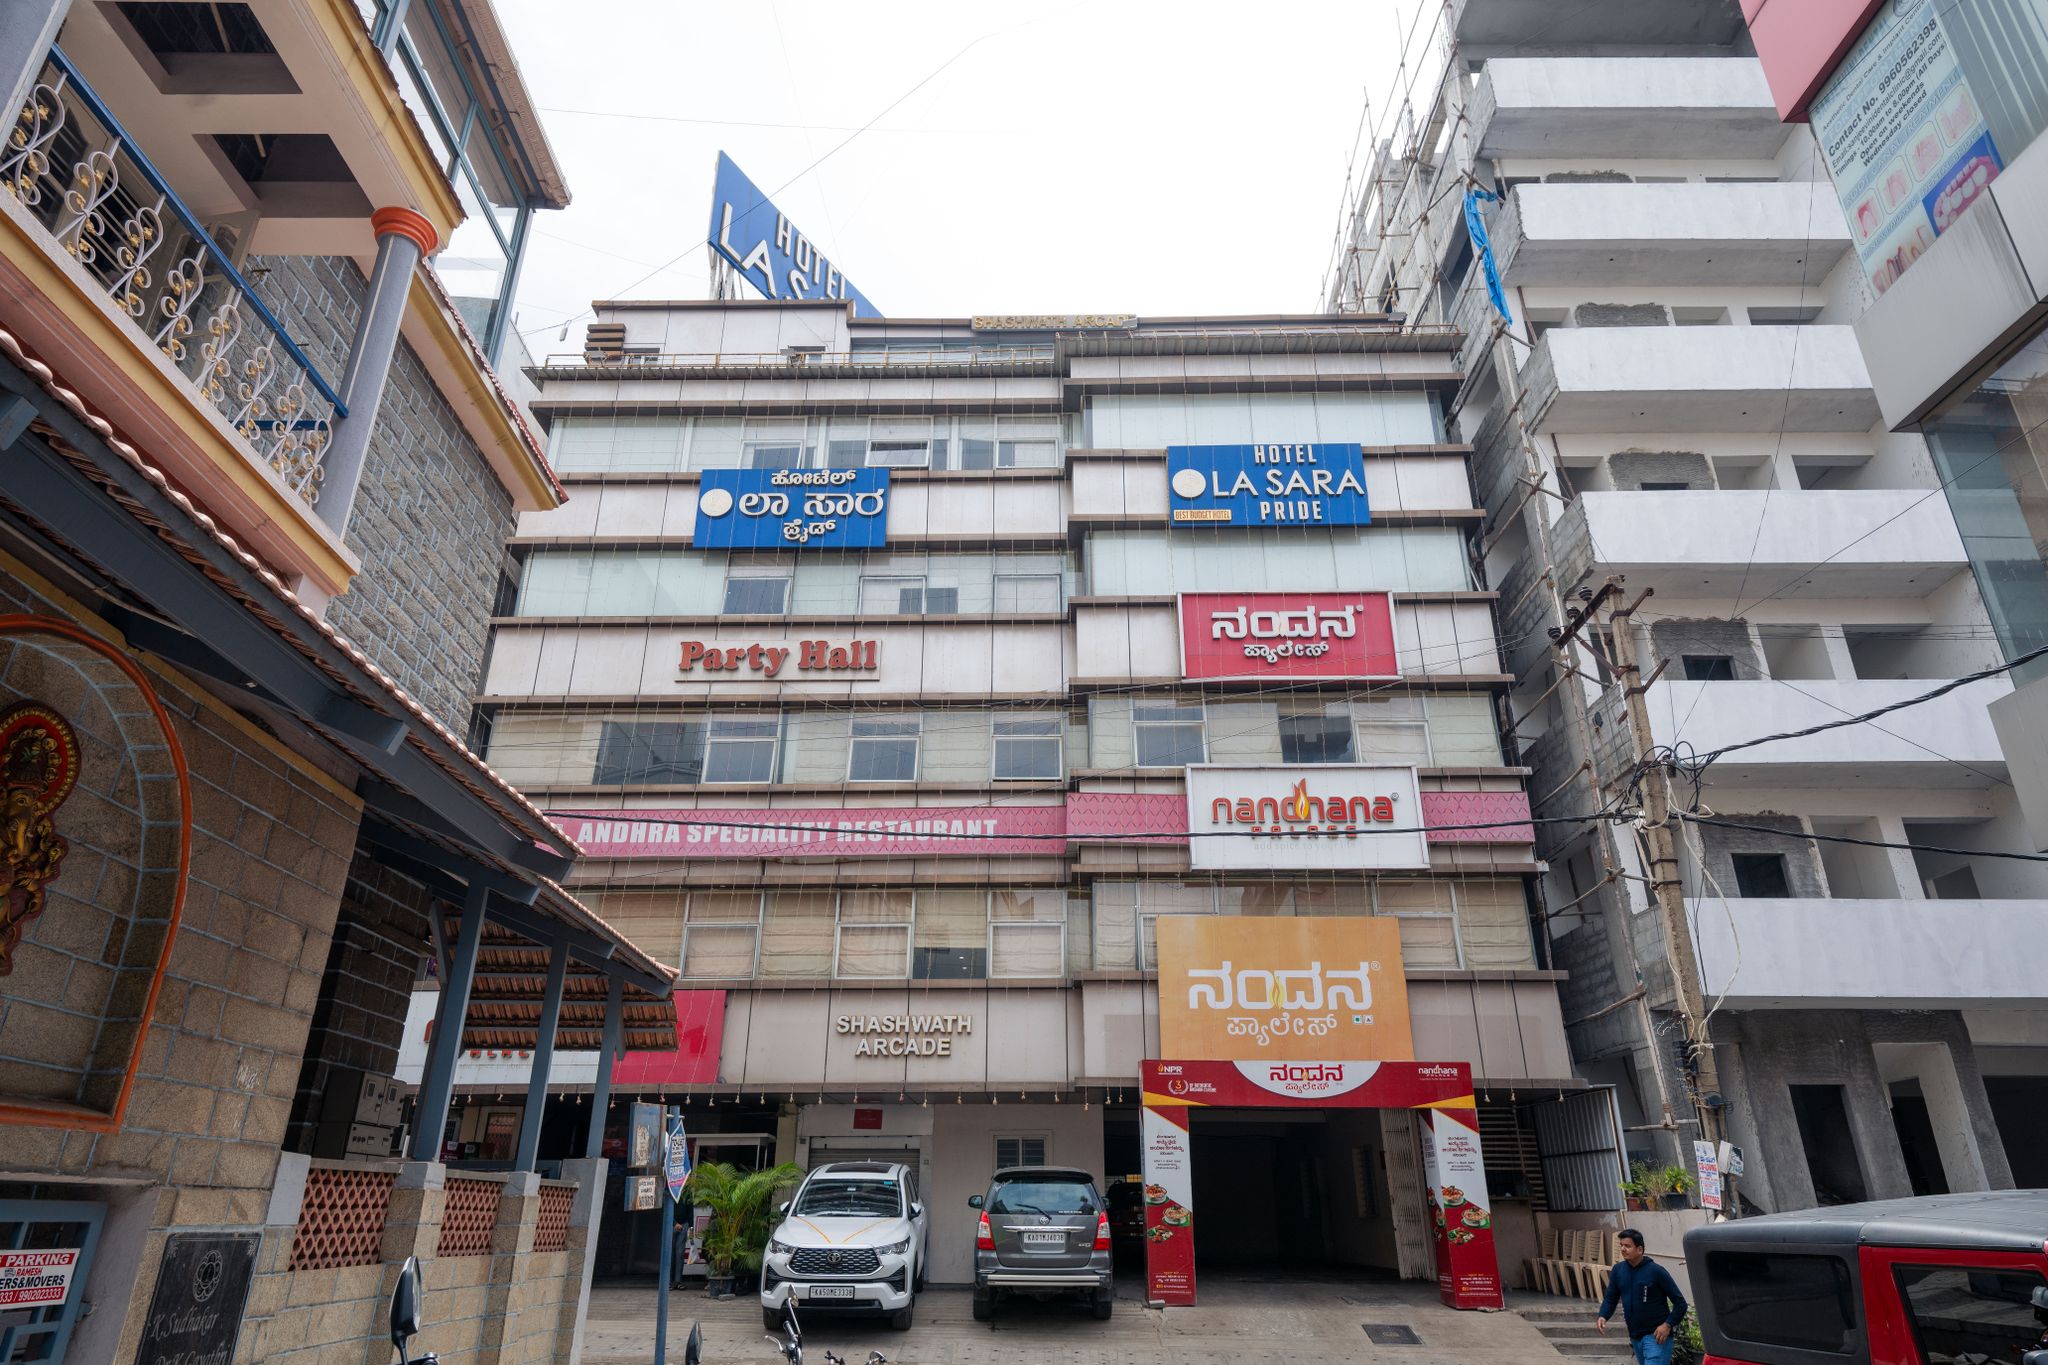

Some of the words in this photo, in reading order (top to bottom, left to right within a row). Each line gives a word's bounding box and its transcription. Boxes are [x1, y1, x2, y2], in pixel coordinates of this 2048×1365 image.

[1828, 112, 1861, 157] Contact
[1862, 92, 1878, 114] No.
[1878, 17, 1937, 94] 9960562398
[1835, 149, 1857, 177] Timings
[1860, 115, 1885, 147] 10.00am
[1884, 105, 1892, 117] to
[1892, 78, 1916, 108] 8.00pm
[1914, 62, 1927, 80] (All
[1859, 136, 1878, 160] Open
[1878, 124, 1887, 138] on
[1888, 80, 1924, 126] weekends
[1863, 120, 1901, 167] Wednesday
[1902, 88, 1927, 121] closed
[1254, 445, 1317, 463] HOTEL
[771, 470, 856, 485] ಹೋಟೆಲ್
[1212, 470, 1259, 496] LA
[1266, 469, 1365, 496] SARA
[739, 493, 789, 516] ಲಾ
[803, 489, 885, 516] ಸಾರ
[1260, 501, 1322, 520] PRIDE
[1211, 605, 1356, 638] ನಂದನ
[679, 641, 789, 677] Party
[798, 641, 877, 669] Hall
[1212, 778, 1395, 823] nandhana
[577, 822, 681, 843] ANDHRA
[687, 821, 831, 843] SPECIALITY
[837, 819, 998, 842] RESTAURANT
[1188, 961, 1373, 1010] ನಂದನ
[837, 1016, 972, 1033] SHASHWATH
[1227, 1012, 1337, 1046] ಪ್ಯಾಲೇಸ್
[855, 1038, 951, 1056] ARCADE
[1164, 1065, 1183, 1073] NPR
[1270, 1064, 1343, 1081] ನಂದನ
[1418, 1064, 1457, 1074] nandhana
[6, 1254, 70, 1266] PARKING
[16, 1268, 43, 1276] RAMESH
